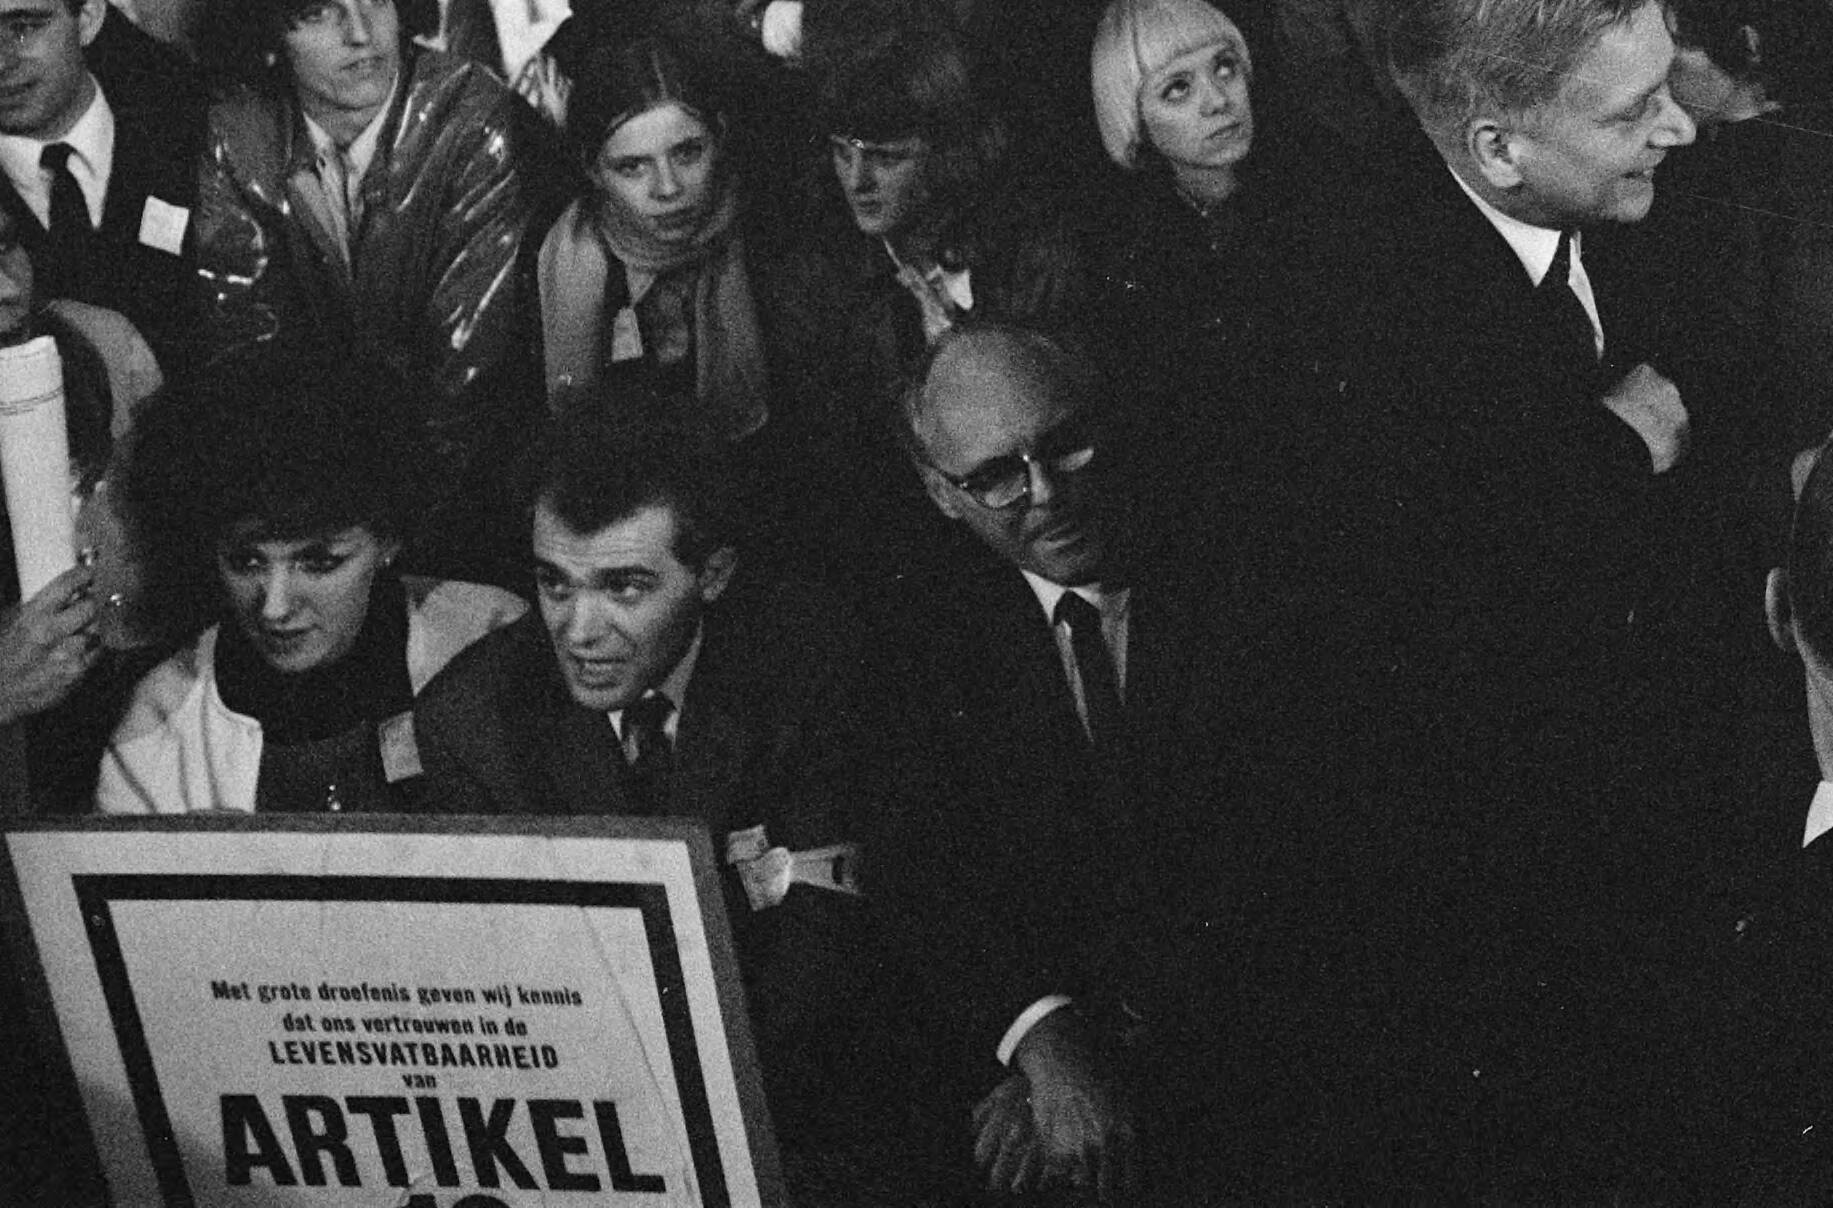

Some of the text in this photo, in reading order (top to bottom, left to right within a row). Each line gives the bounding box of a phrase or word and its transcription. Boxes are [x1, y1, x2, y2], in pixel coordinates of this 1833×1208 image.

[210, 980, 583, 1008] Met grote droefenis geven wij kennis
[282, 1013, 529, 1037] dat ons vertrouwen in de
[267, 1040, 559, 1070] LEVENSVATBAARHEID
[402, 1073, 438, 1090] van
[218, 1093, 668, 1193] ARTIKEL
